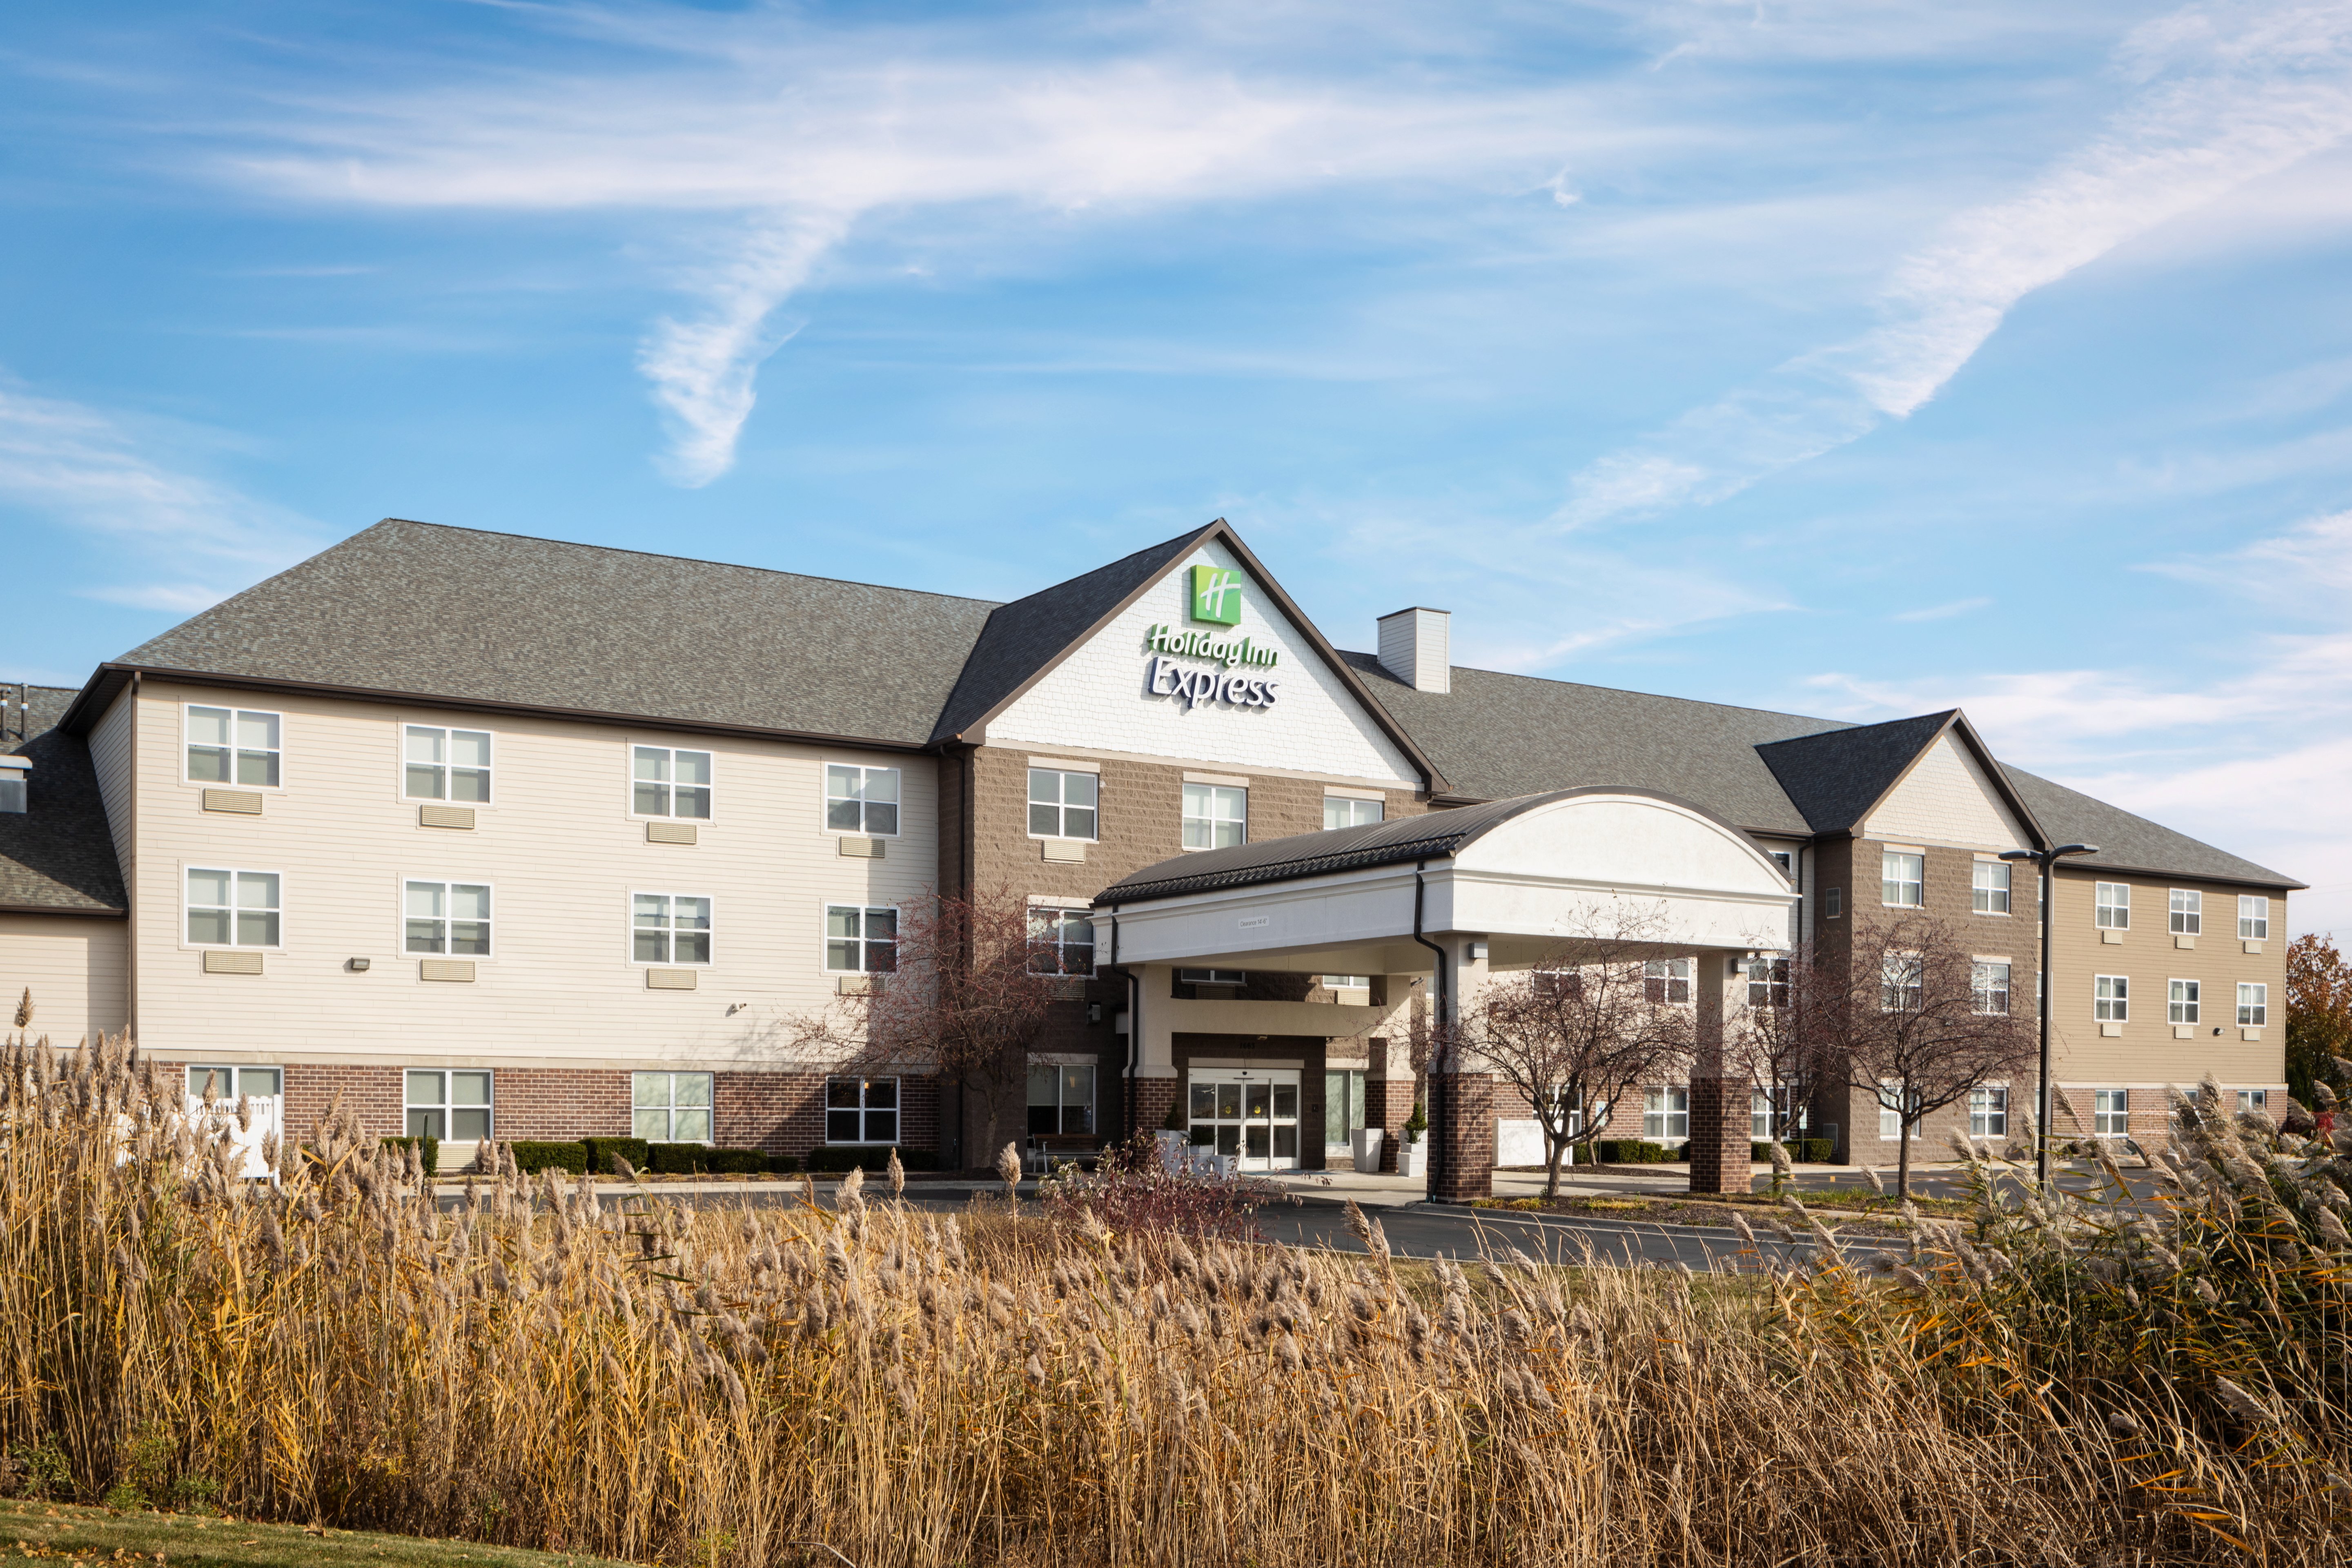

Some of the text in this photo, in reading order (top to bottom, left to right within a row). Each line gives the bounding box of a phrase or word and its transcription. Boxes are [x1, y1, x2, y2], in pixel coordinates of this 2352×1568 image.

[1200, 572, 1241, 618] H
[1148, 623, 1281, 667] Holiday Inn
[1149, 656, 1281, 709] Express
